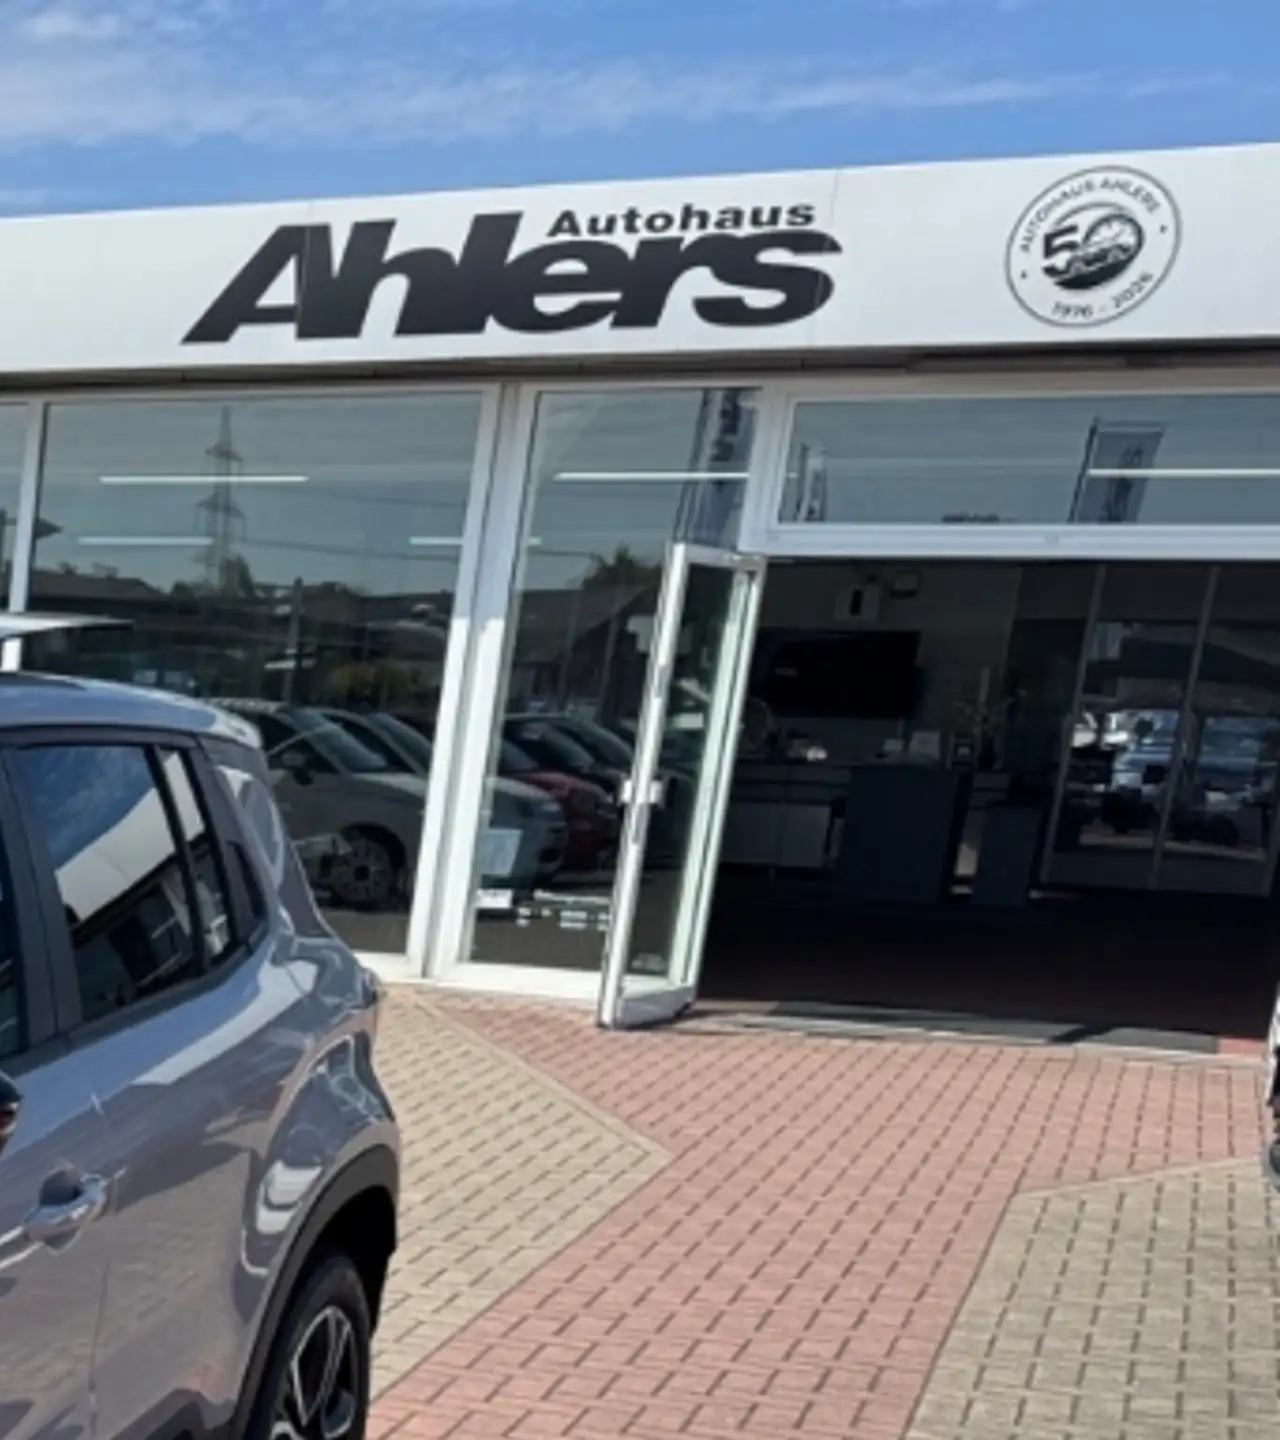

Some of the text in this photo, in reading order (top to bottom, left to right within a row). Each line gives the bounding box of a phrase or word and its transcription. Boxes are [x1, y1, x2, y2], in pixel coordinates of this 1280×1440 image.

[545, 203, 816, 238] Autohaus
[1021, 178, 1161, 252] AUTOHAUS AHLERS
[180, 211, 843, 344] Ahlers
